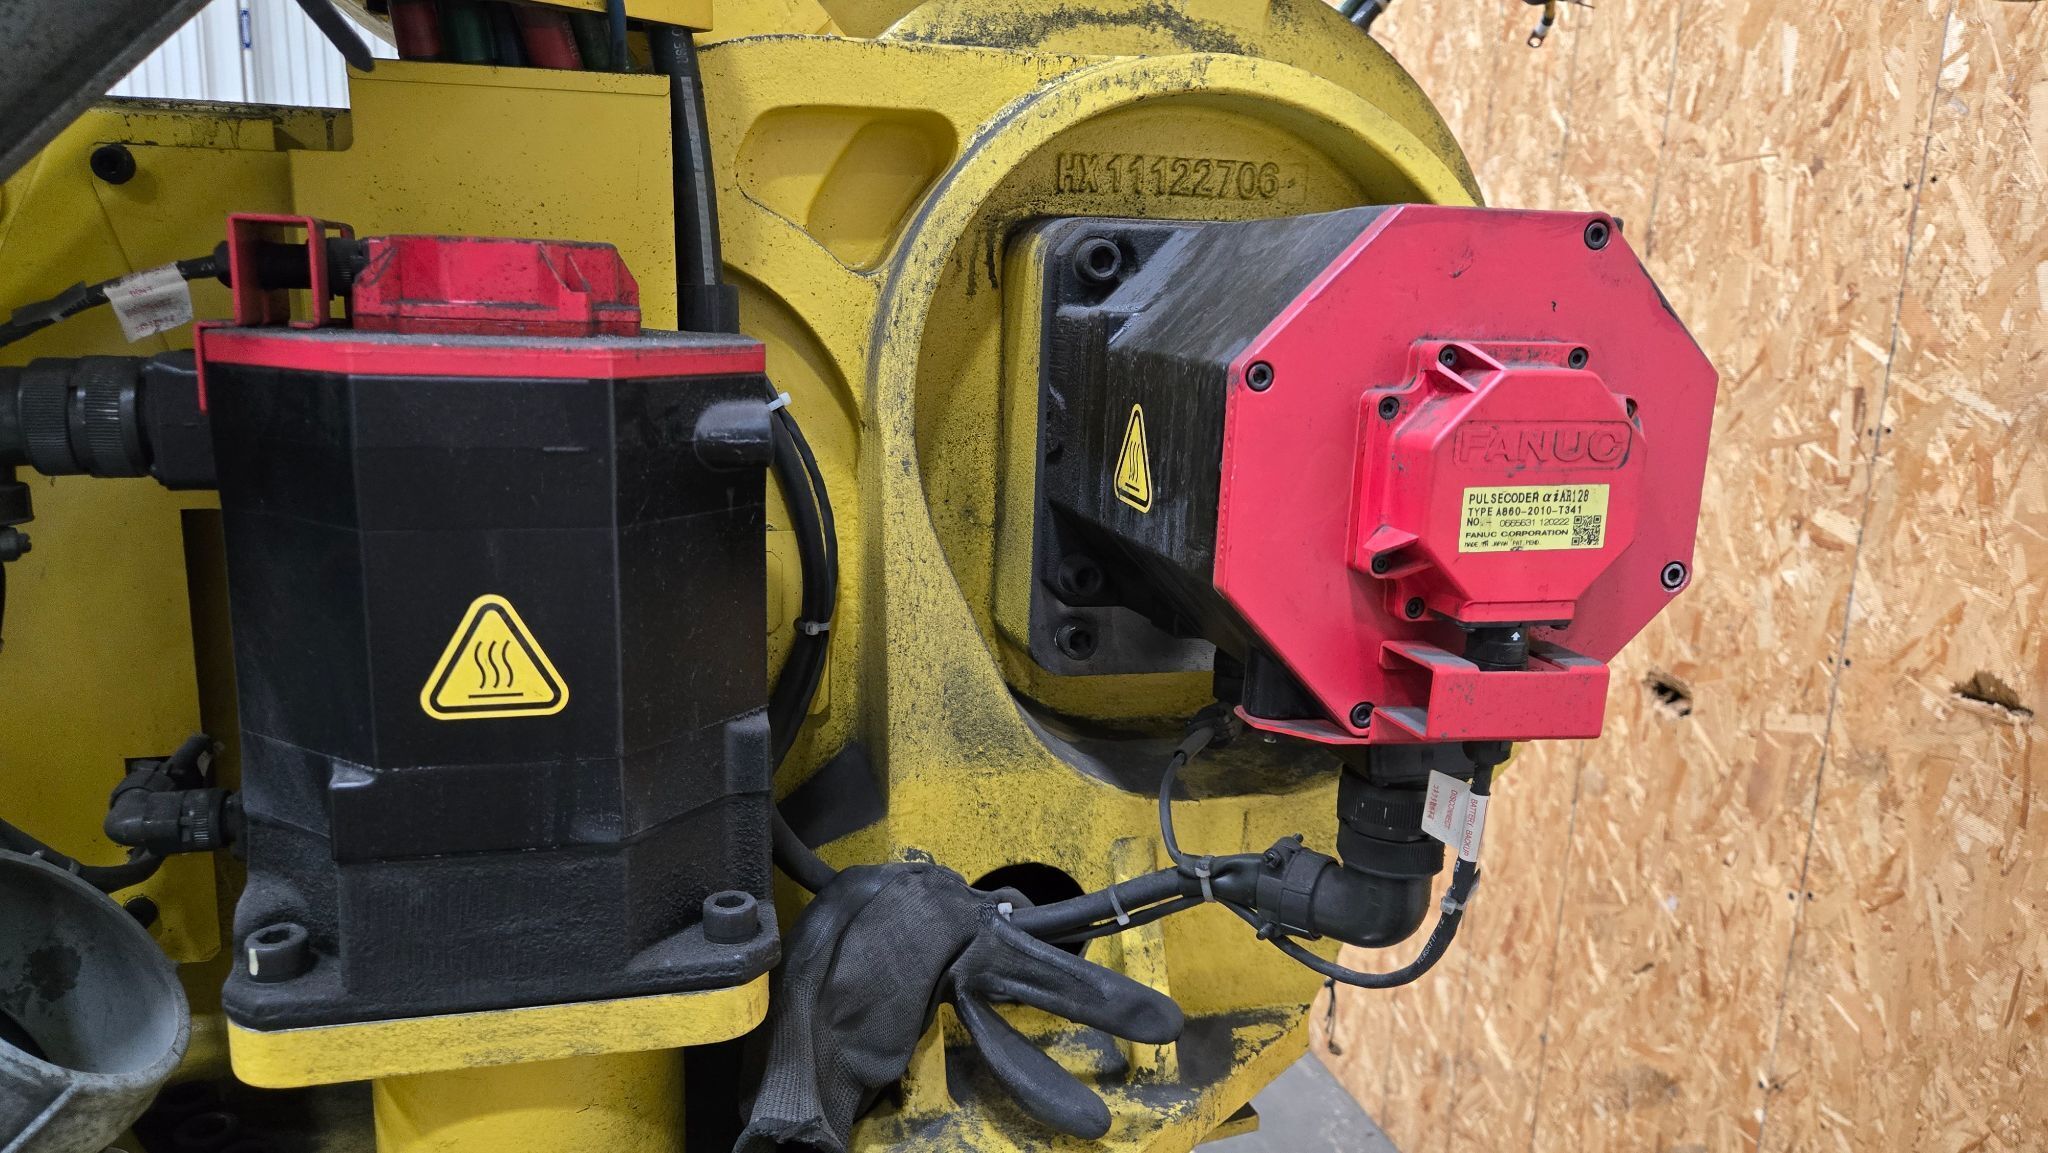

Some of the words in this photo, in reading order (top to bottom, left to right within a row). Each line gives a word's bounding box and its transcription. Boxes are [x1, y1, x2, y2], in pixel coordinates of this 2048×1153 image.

[1056, 152, 1280, 201] HX11122706
[1459, 428, 1623, 463] FANUC
[1468, 491, 1540, 505] PULSECODER
[1467, 506, 1493, 517] TYPE
[1495, 504, 1582, 517] A860-2010-T341
[1501, 529, 1569, 537] CORPORATION
